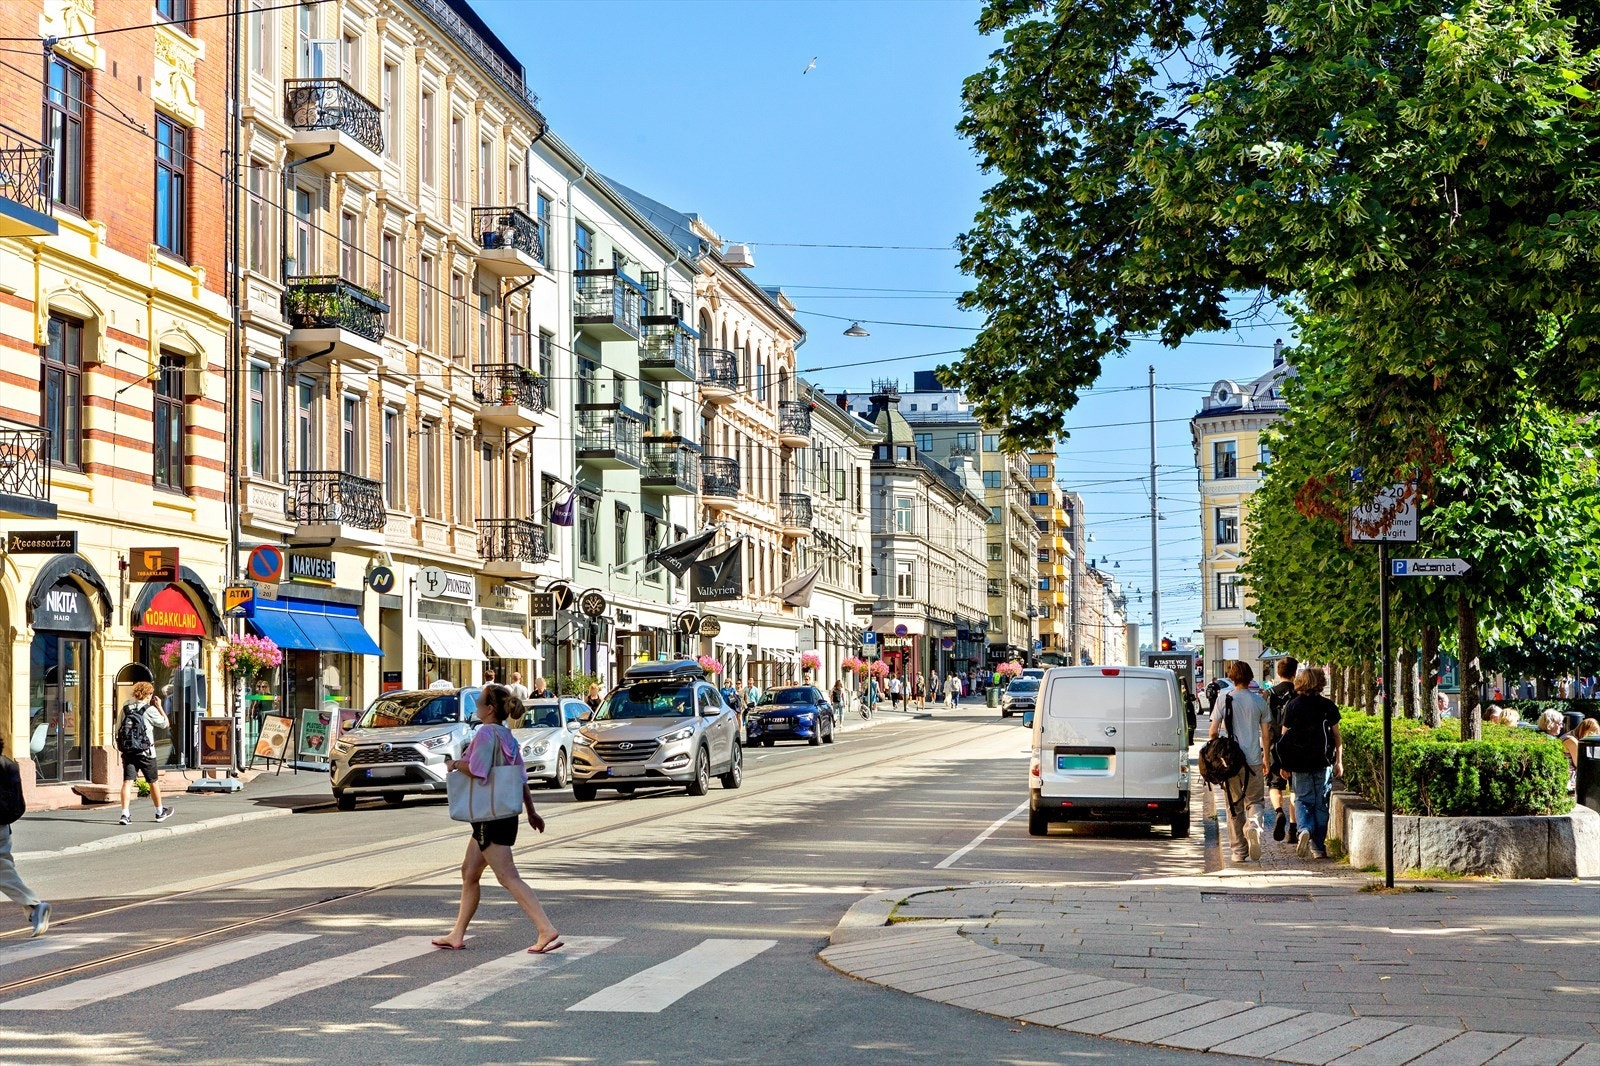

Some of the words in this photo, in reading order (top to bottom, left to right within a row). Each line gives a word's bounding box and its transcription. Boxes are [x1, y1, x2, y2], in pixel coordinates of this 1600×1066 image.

[1390, 487, 1404, 498] 20
[11, 535, 71, 550] Accessorize
[293, 554, 336, 579] NARVESEN
[710, 562, 724, 582] V
[1396, 561, 1404, 573] P
[1412, 562, 1456, 573] Amat
[229, 590, 250, 598] ATM
[697, 585, 735, 596] Valkyrien
[46, 591, 78, 613] NIKITA
[145, 608, 197, 629] TOBAKKLAND
[866, 633, 873, 642] P
